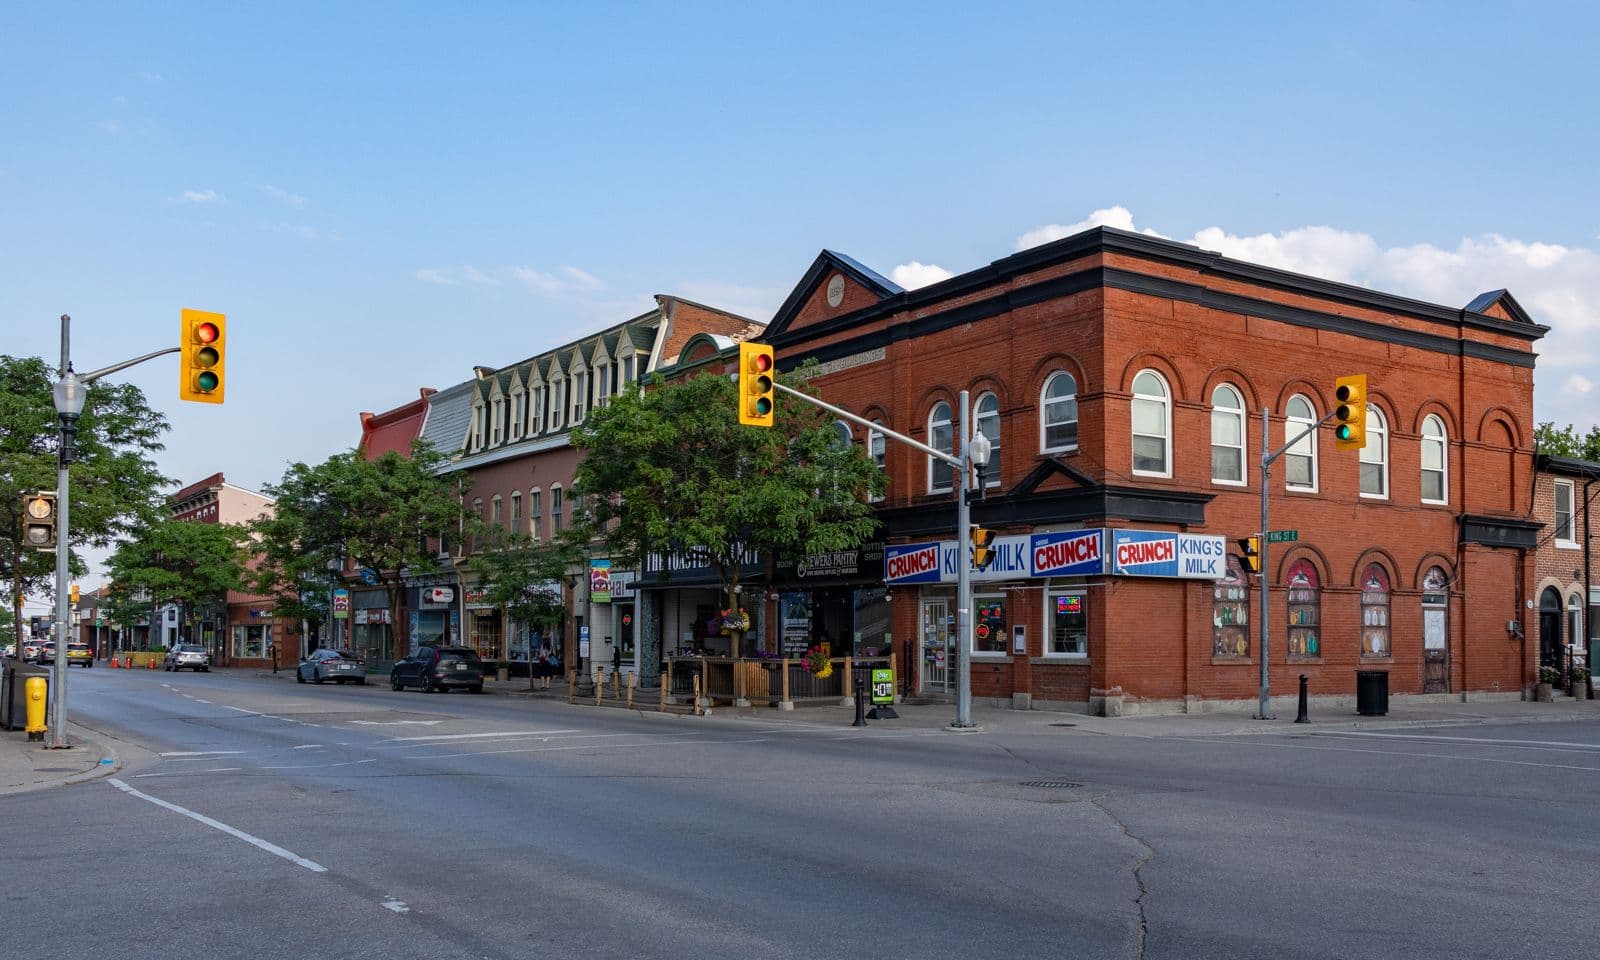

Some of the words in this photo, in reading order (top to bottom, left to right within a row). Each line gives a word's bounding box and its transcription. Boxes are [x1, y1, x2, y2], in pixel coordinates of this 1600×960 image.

[1180, 538, 1223, 557] KING'S
[1270, 532, 1282, 542] KING
[1284, 532, 1290, 541] ST
[647, 549, 664, 572] THE
[833, 551, 859, 566] PANTRY
[865, 552, 883, 561] SHOP
[888, 548, 937, 578] CRUNCH
[992, 543, 1025, 572] MILK
[1036, 535, 1098, 571] CRUNCH
[1118, 541, 1173, 565] CRUNCH
[1185, 558, 1216, 574] MILK
